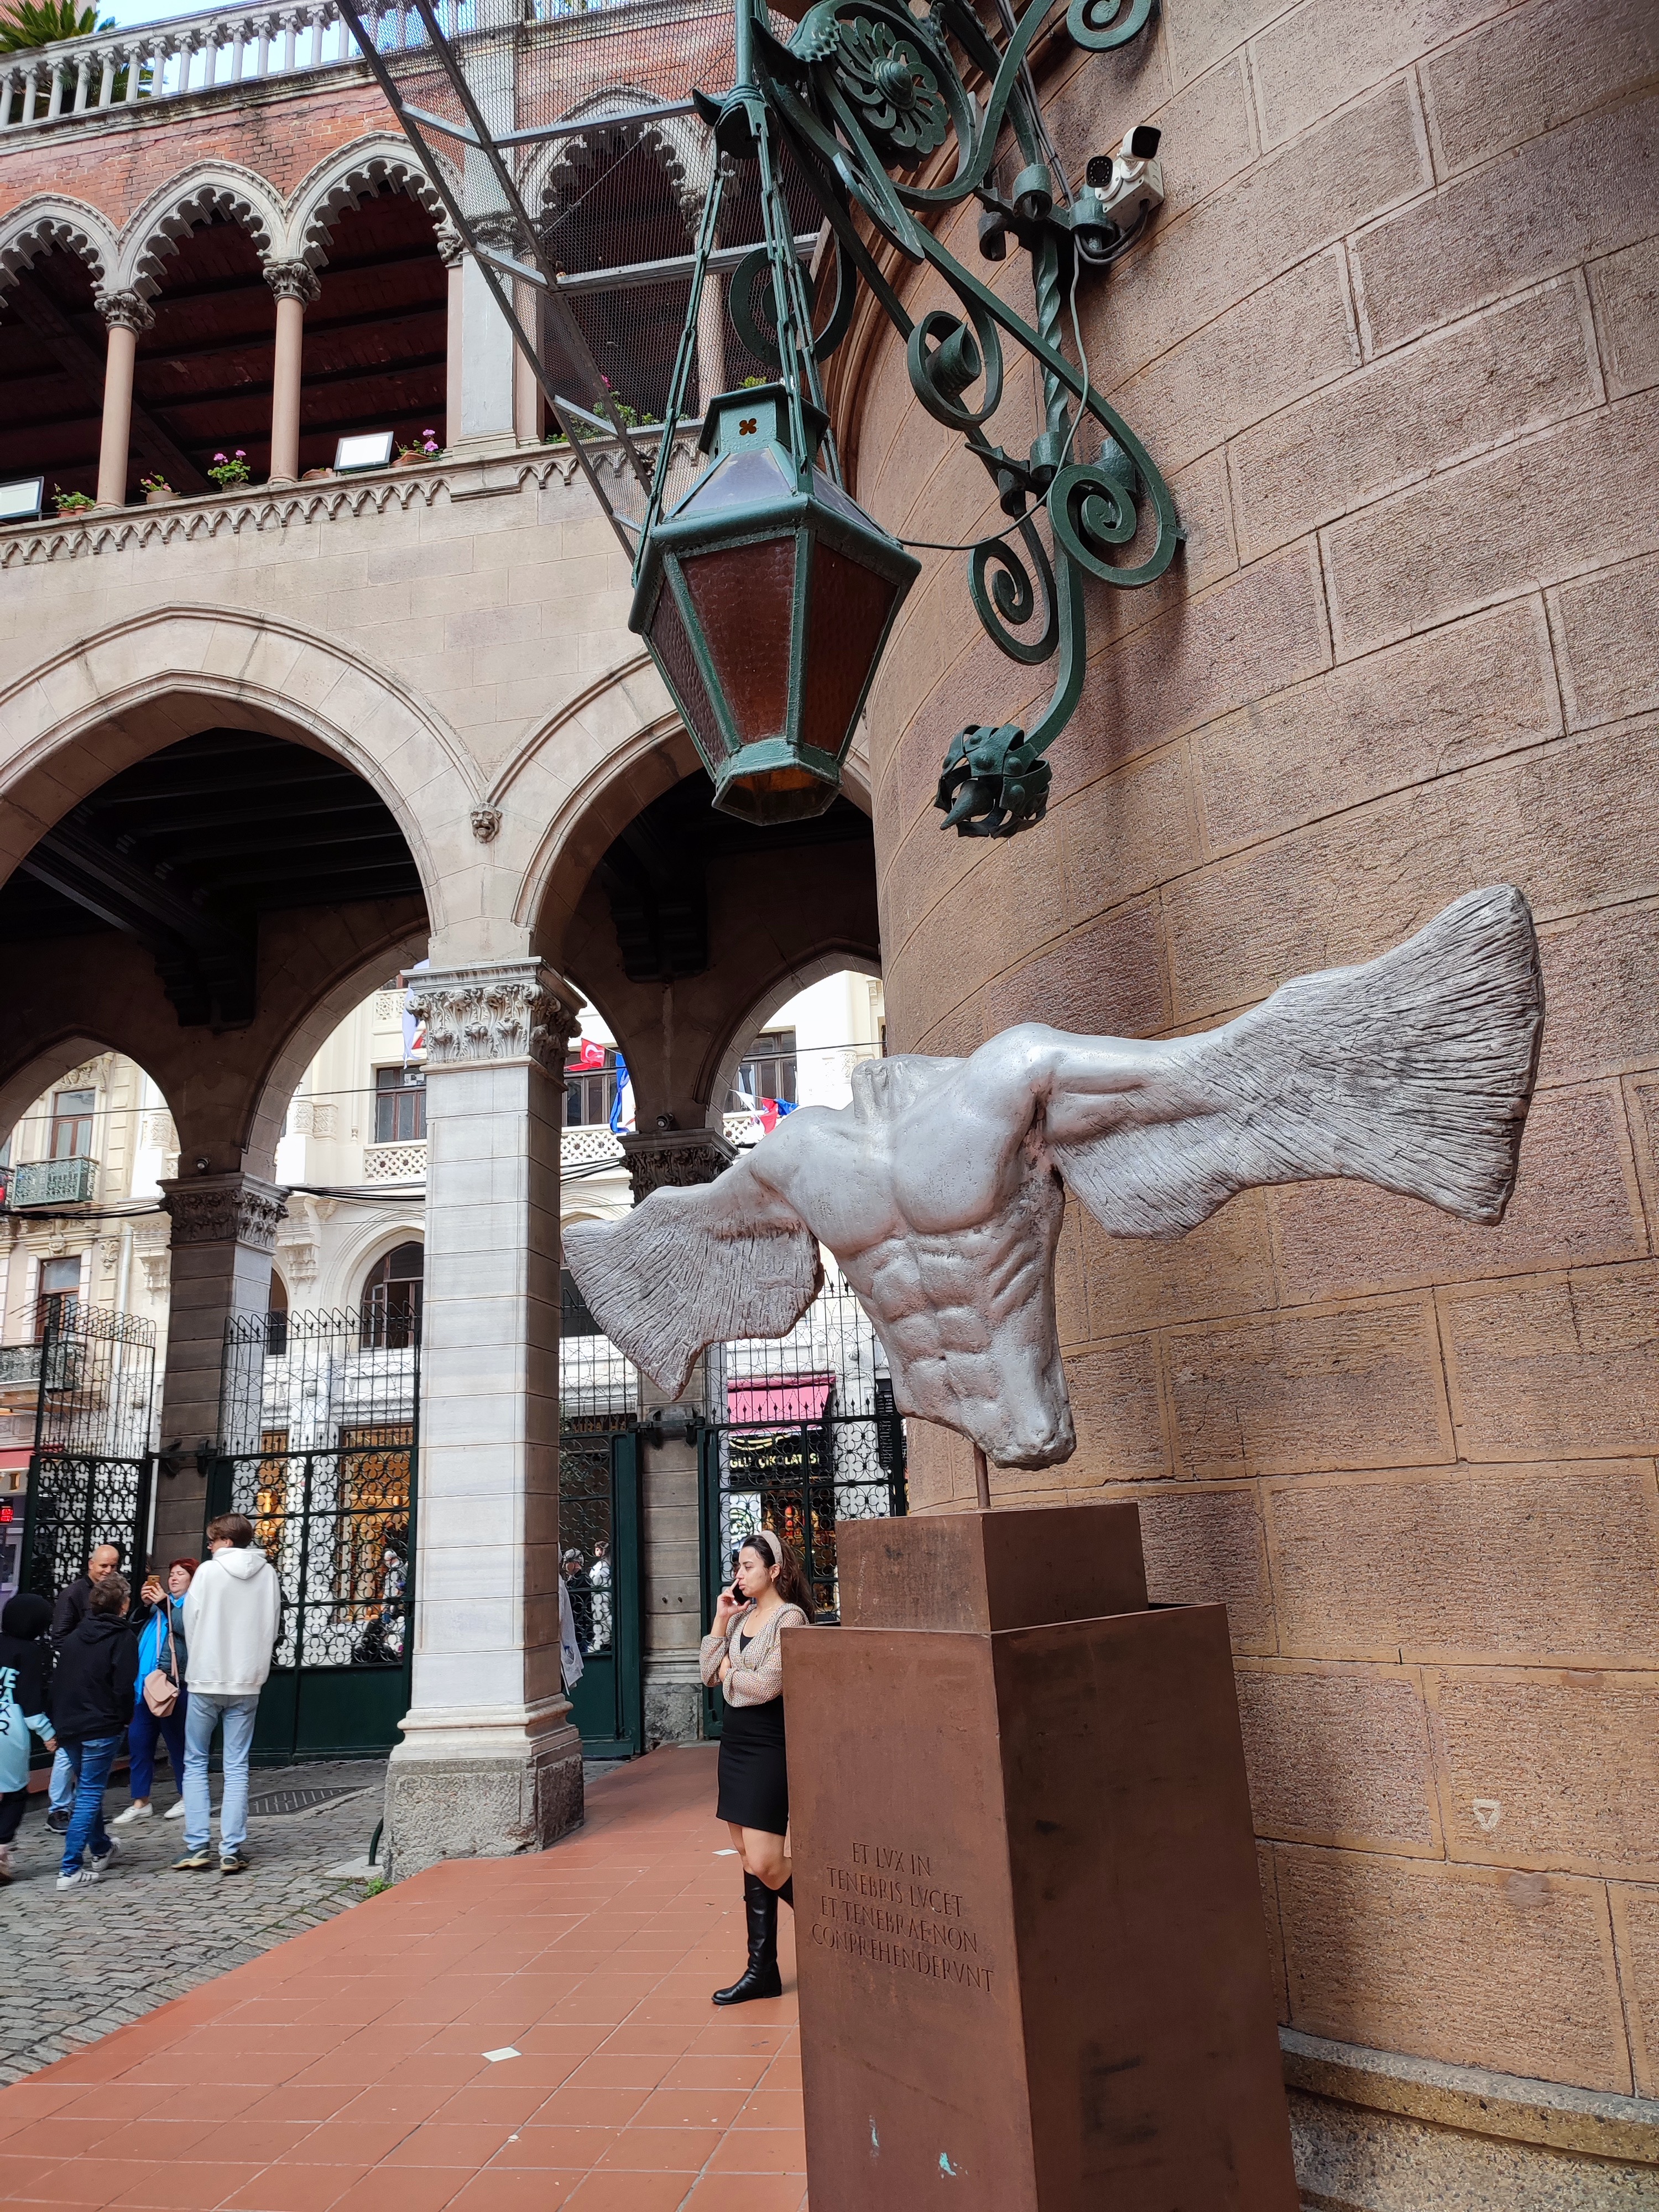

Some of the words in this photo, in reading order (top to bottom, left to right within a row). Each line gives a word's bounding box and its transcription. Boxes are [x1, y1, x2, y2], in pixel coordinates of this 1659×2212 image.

[852, 1842, 870, 1865] ET
[876, 1846, 905, 1873] LVX
[911, 1854, 931, 1877] IN
[827, 1867, 902, 1904] TENEBRIS
[909, 1885, 963, 1917] LVCET
[821, 1895, 838, 1918] ET
[842, 1901, 930, 1942] TENEBRAE
[932, 1923, 978, 1954] NON
[811, 1923, 994, 1992] CONPREHENDERVNT
